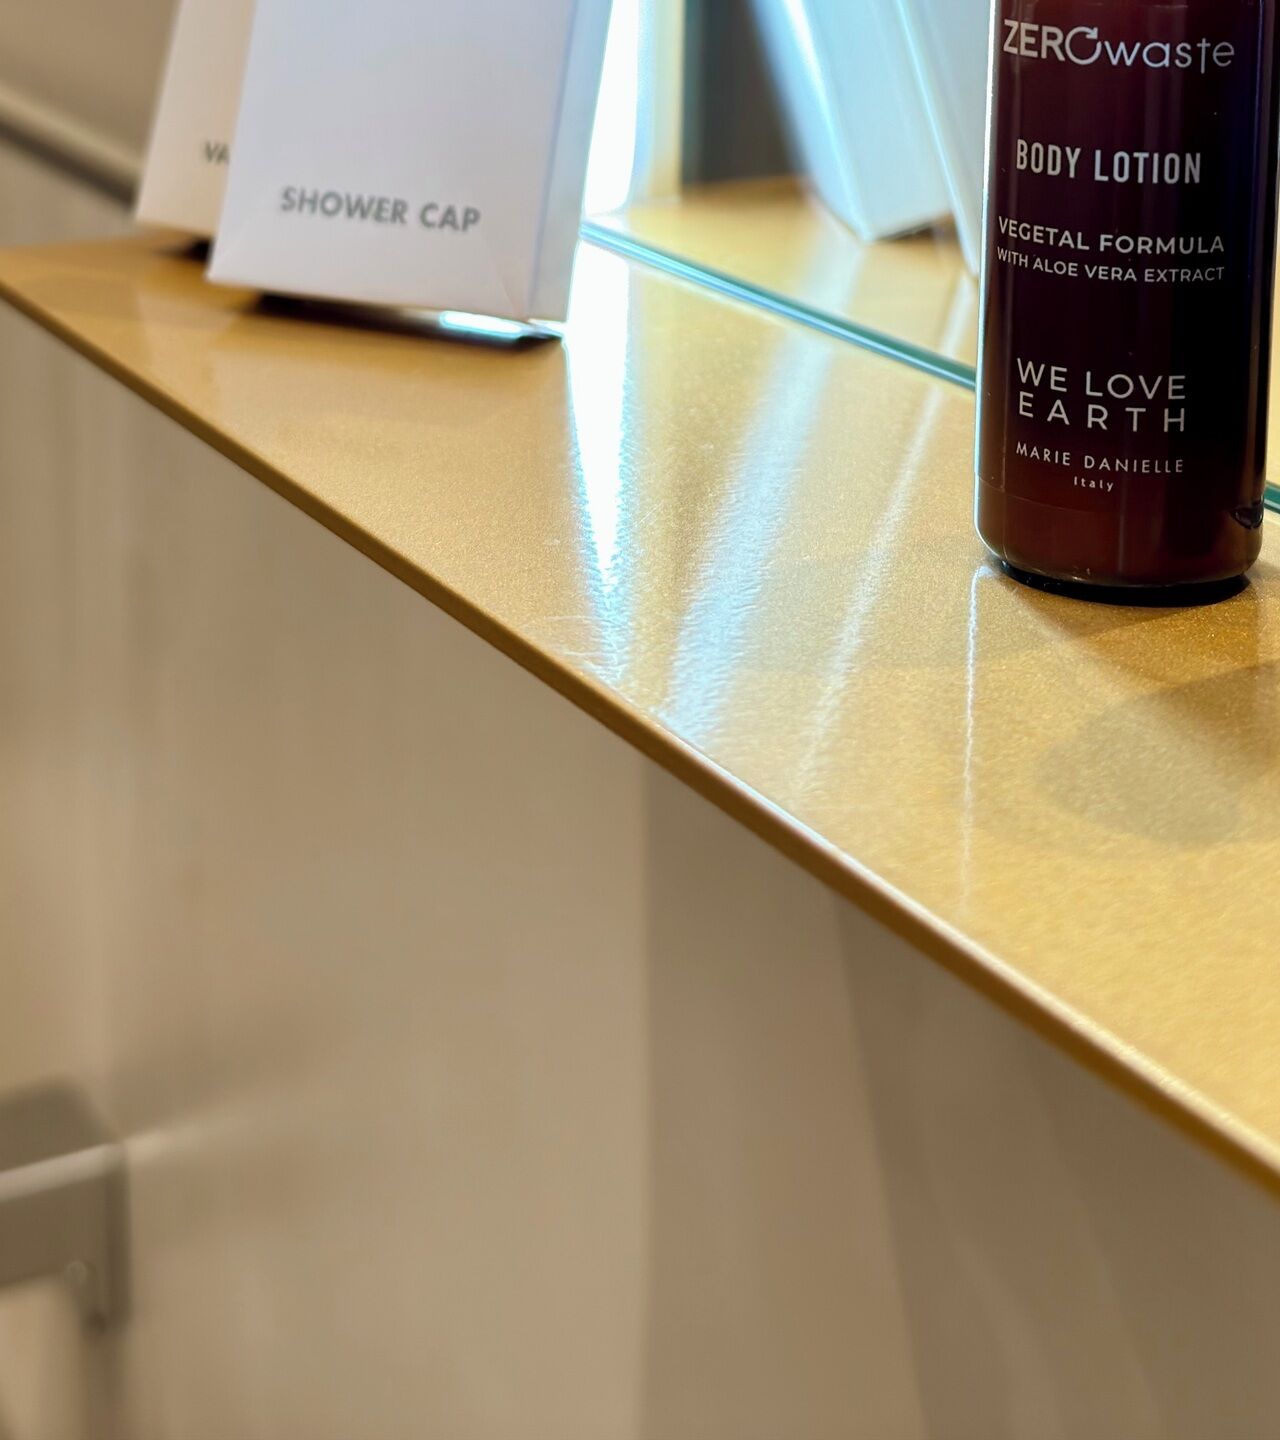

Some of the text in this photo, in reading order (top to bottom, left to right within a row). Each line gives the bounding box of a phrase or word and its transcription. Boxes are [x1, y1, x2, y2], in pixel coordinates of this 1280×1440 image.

[1016, 139, 1201, 184] BODY LOTION
[280, 186, 481, 233] SHOWER CAP
[998, 216, 1224, 254] VEGETAL FORMULA
[997, 247, 1225, 284] WITH ALOE VERA EXTRACT
[1017, 357, 1186, 400] WE LOVE
[1019, 391, 1185, 433] EARTH
[1016, 441, 1183, 473] MARIE DANIELLE
[1074, 476, 1114, 492] Italy
